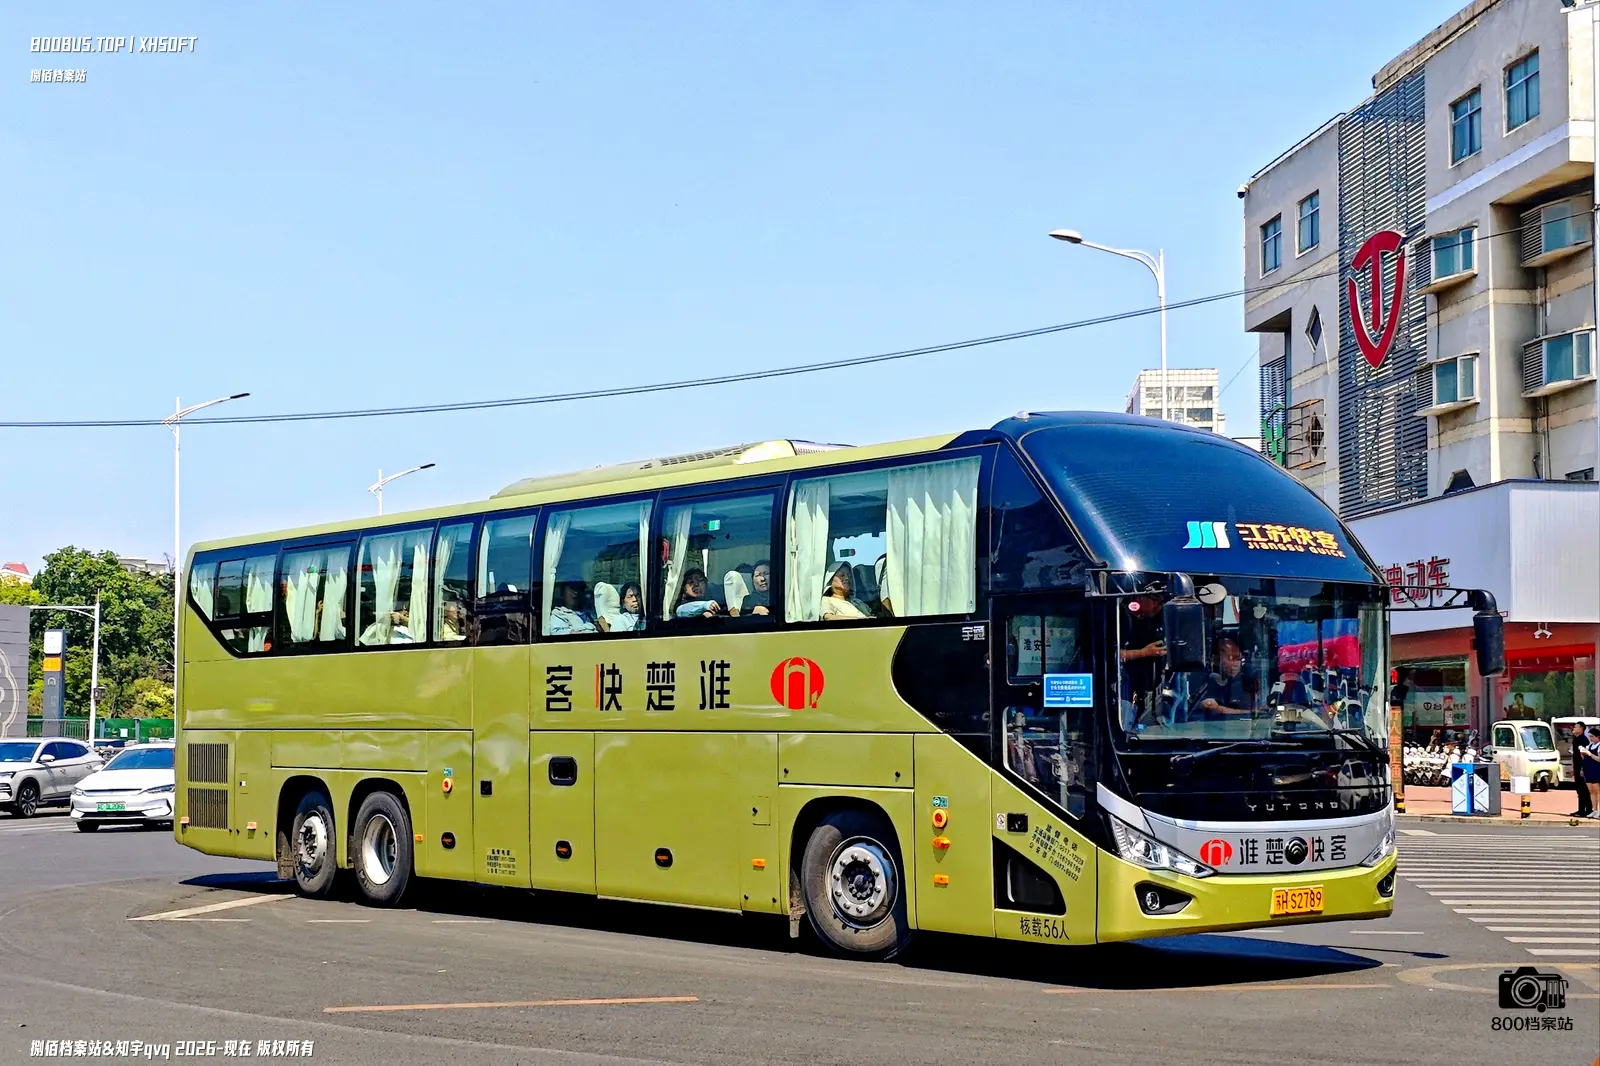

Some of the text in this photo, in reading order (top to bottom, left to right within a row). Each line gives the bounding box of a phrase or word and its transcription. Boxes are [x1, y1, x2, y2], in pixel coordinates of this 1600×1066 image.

[1235, 522, 1339, 550] 江苏快客
[1380, 556, 1450, 603] 电动车
[1248, 801, 1340, 812] YUTONG
[1020, 916, 1070, 940] 核载56人
